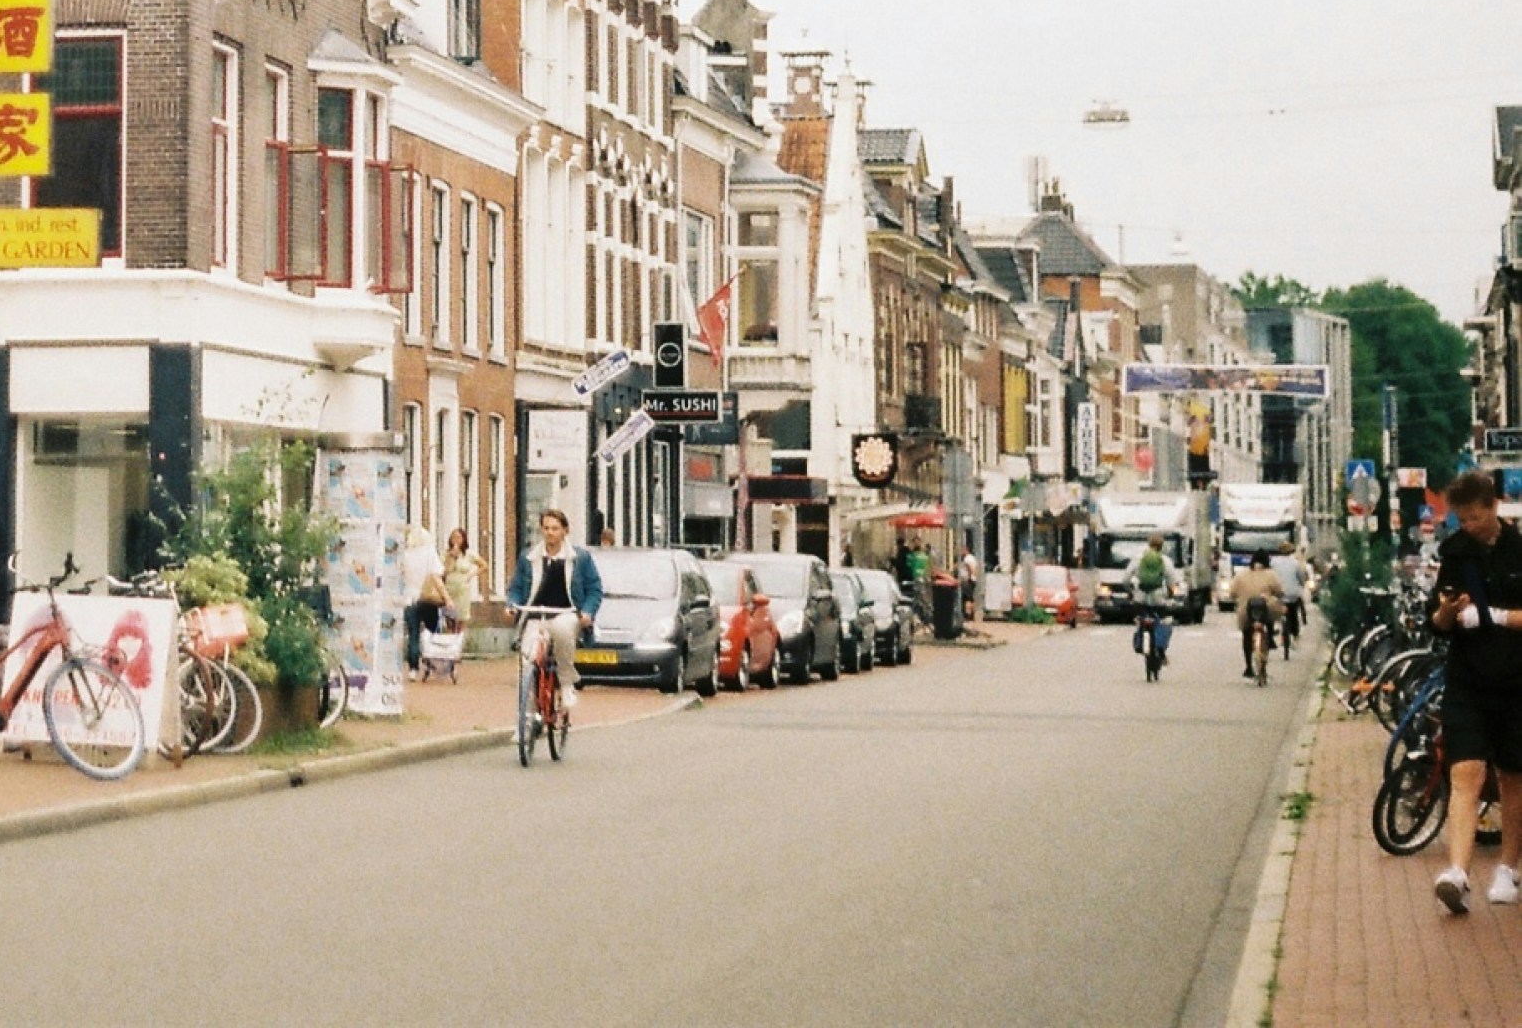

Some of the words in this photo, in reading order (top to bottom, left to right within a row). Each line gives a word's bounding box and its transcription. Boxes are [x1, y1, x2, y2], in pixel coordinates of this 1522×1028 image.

[3, 240, 91, 260] GARDEN
[646, 399, 669, 411] Mr.
[672, 398, 716, 412] SUSHI
